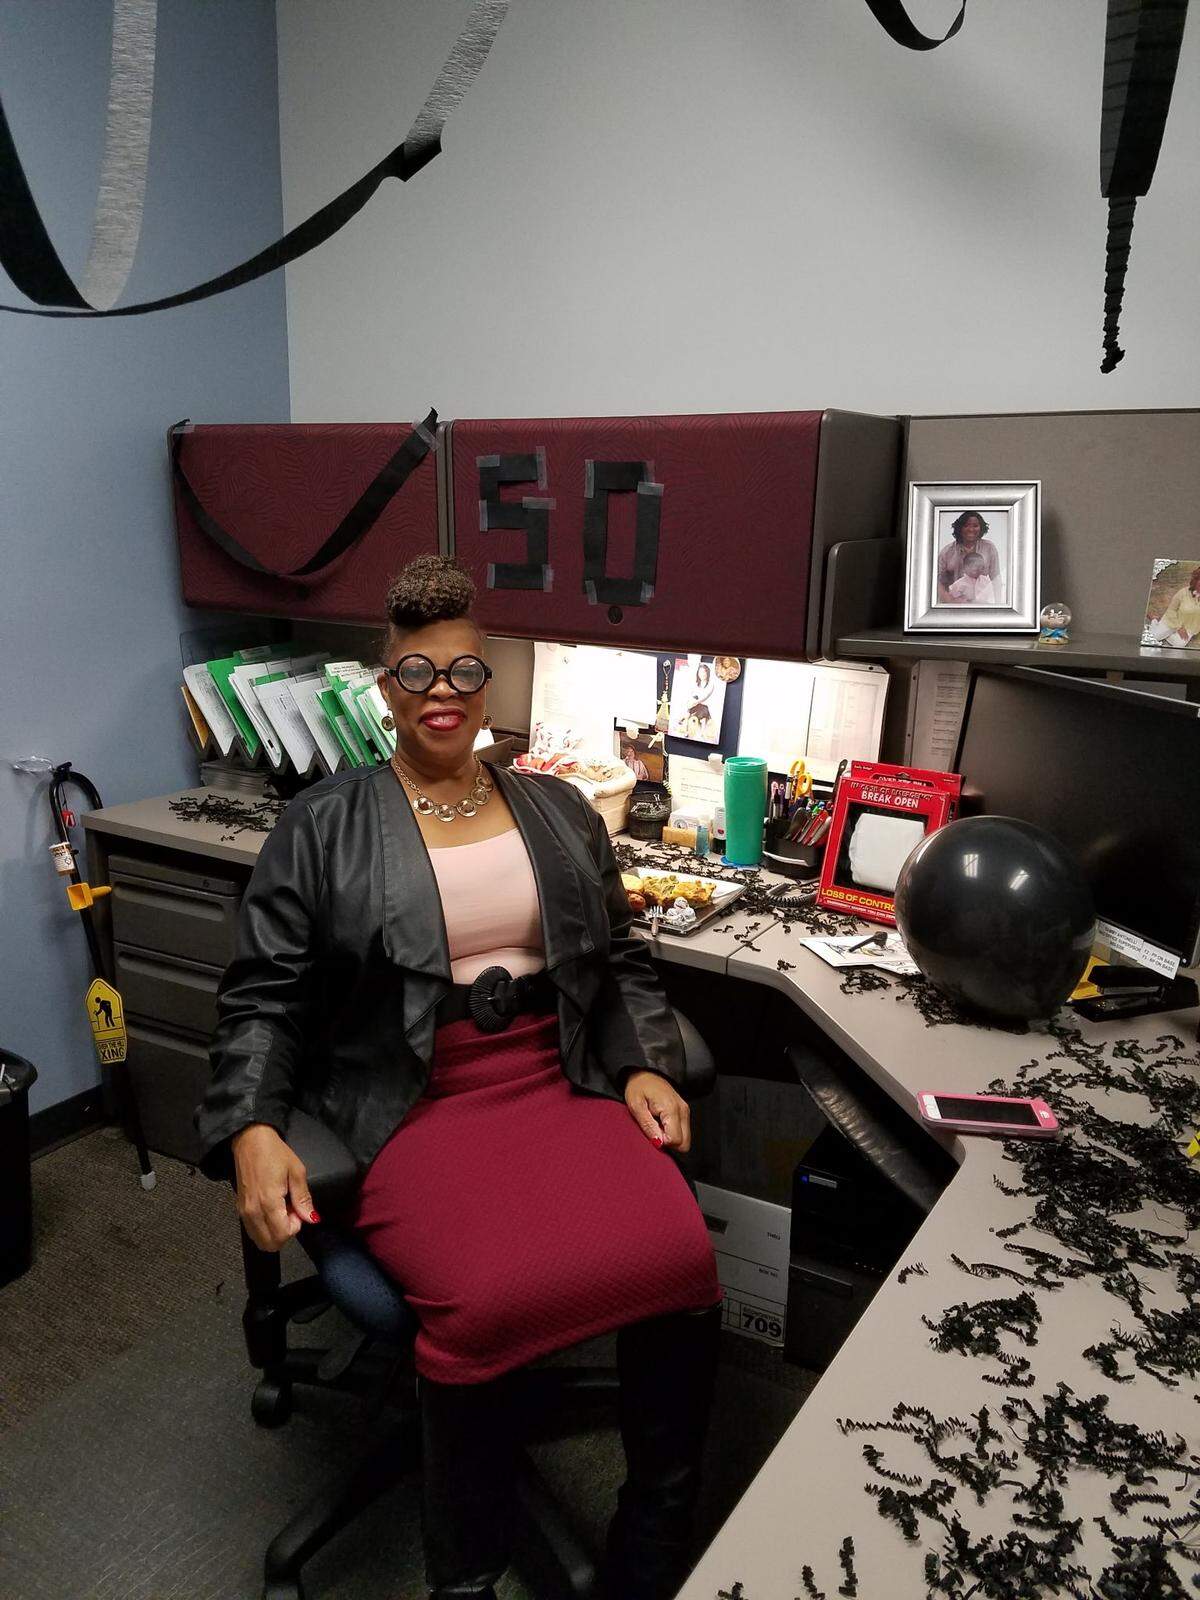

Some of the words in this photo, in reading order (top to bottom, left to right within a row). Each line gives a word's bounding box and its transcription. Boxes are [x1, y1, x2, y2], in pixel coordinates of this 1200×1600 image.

[861, 790, 891, 804] BREAK
[894, 796, 919, 809] OPEN
[821, 888, 845, 900] LOSS
[845, 893, 858, 903] OF
[859, 897, 896, 912] CONTRO
[101, 1047, 125, 1060] XING
[742, 1312, 783, 1339] 709
